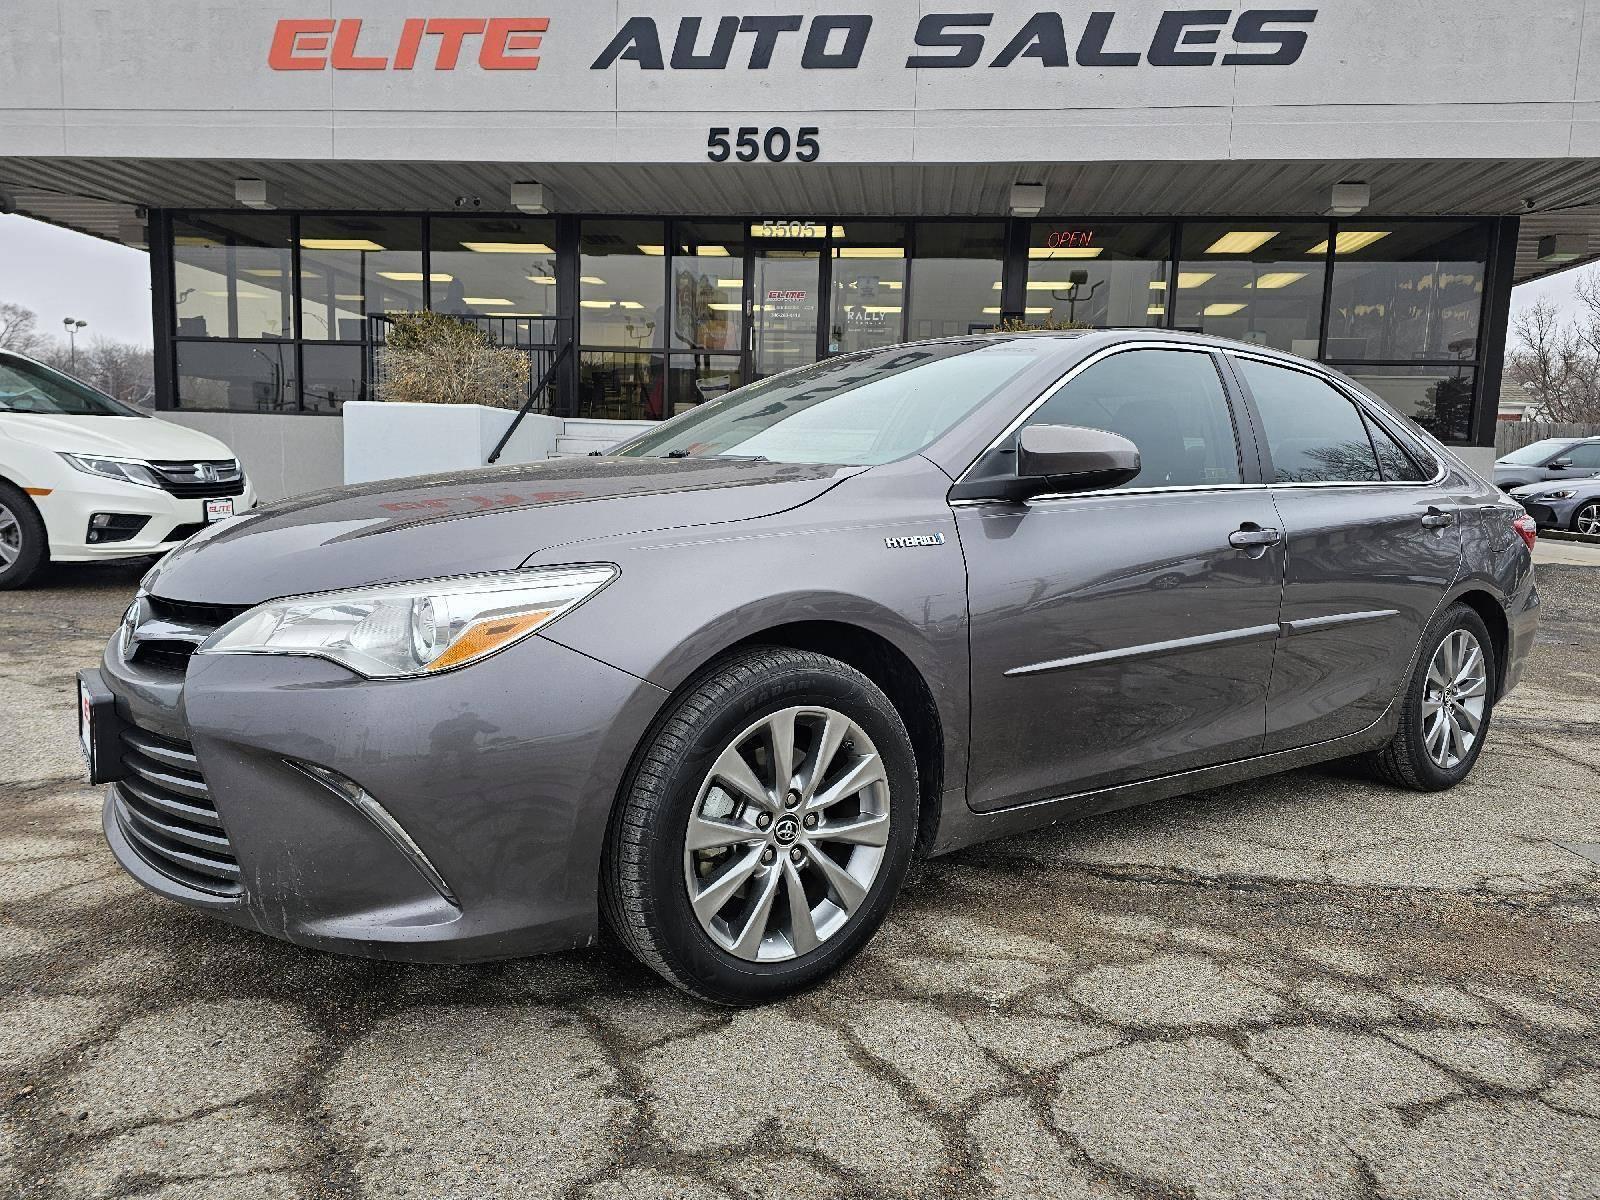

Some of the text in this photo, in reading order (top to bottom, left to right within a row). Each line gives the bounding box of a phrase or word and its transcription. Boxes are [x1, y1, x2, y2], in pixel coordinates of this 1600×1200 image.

[268, 10, 1318, 71] ELITE AUTO SALES
[707, 126, 820, 164] 5505
[762, 220, 816, 238] 5505
[1048, 231, 1093, 248] OPEN
[768, 290, 806, 299] ELITE
[847, 311, 886, 321] RALLY
[884, 534, 938, 549] HYBRID
